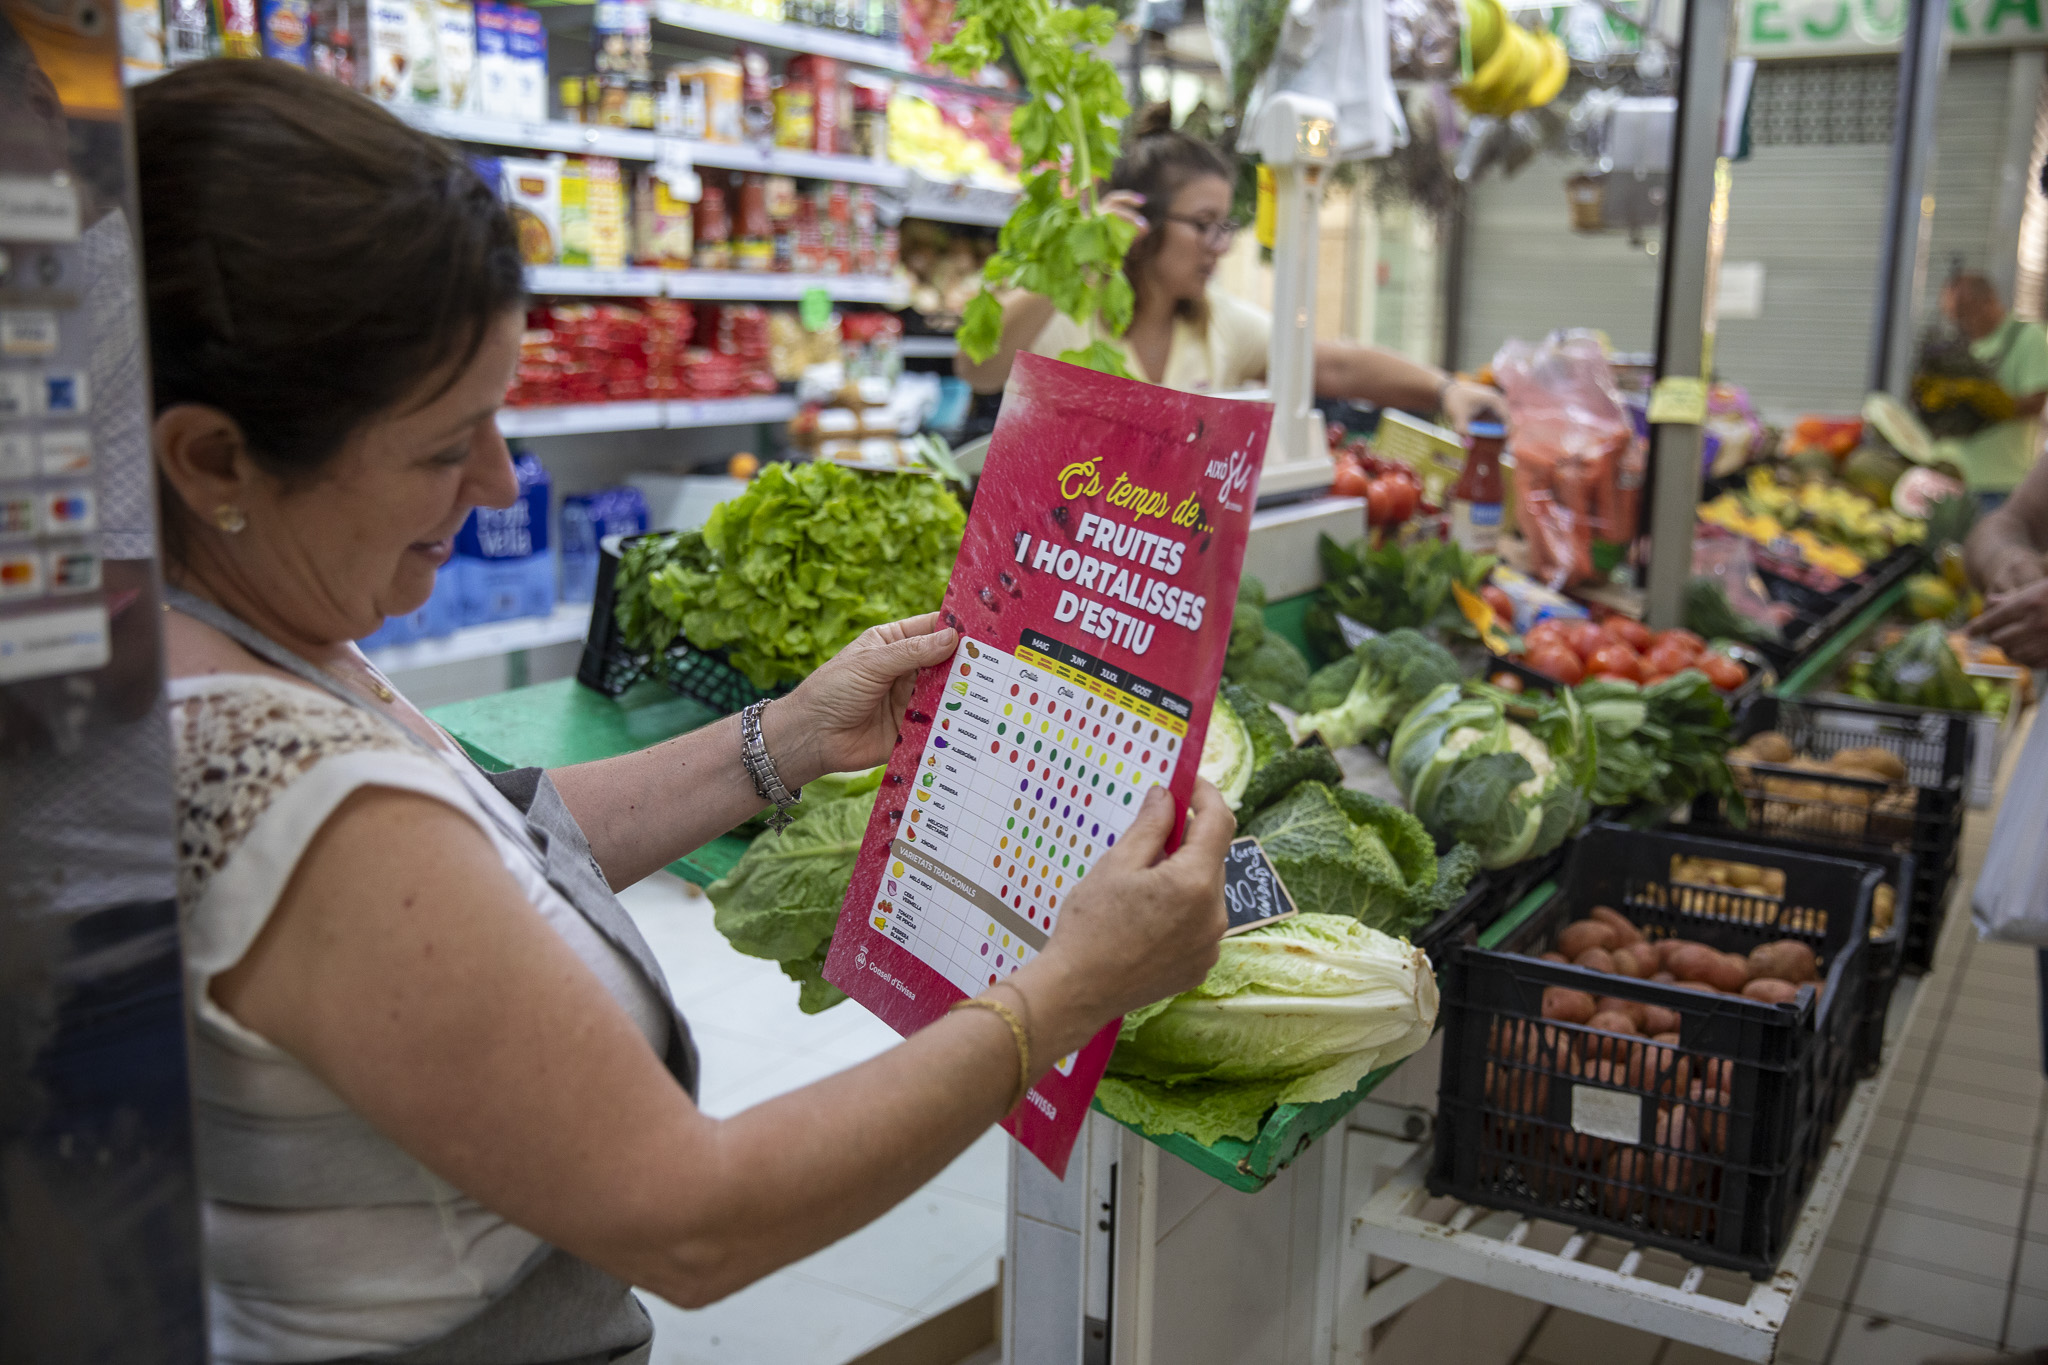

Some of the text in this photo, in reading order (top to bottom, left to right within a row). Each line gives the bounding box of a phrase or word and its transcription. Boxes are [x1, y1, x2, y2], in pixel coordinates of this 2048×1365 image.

[1057, 456, 1214, 534] És temps de...
[1075, 512, 1186, 576] FRUITES
[1015, 533, 1206, 631] I HORTALISSES
[1053, 590, 1156, 655] D'ESTIU
[1031, 638, 1050, 651] MAIG
[982, 653, 999, 664] PATATA
[1069, 654, 1087, 668] JUNY
[976, 671, 994, 683] TOMATA
[1100, 668, 1118, 683] JULIOL
[969, 691, 989, 703] LLETUGA
[1131, 683, 1153, 698] AGOST
[963, 710, 990, 725] CARABASSÓ
[945, 764, 957, 774] CEBA
[939, 783, 958, 796] PEBRERA
[933, 800, 945, 811] MELÓ
[926, 823, 949, 839] NECTARINA
[927, 817, 949, 832] MELICOTÓ
[900, 846, 976, 898] VARIETATS TRADICIONALS
[909, 874, 921, 884] MELÓ
[903, 891, 915, 901] CEBA
[902, 896, 922, 912] VERMELLA
[896, 913, 917, 931] DE PENJAR
[898, 908, 914, 922] TOMATA
[890, 931, 906, 945] BLANCA
[891, 926, 909, 941] PEBRERA
[869, 961, 916, 1001] Consell d'Eivissa
